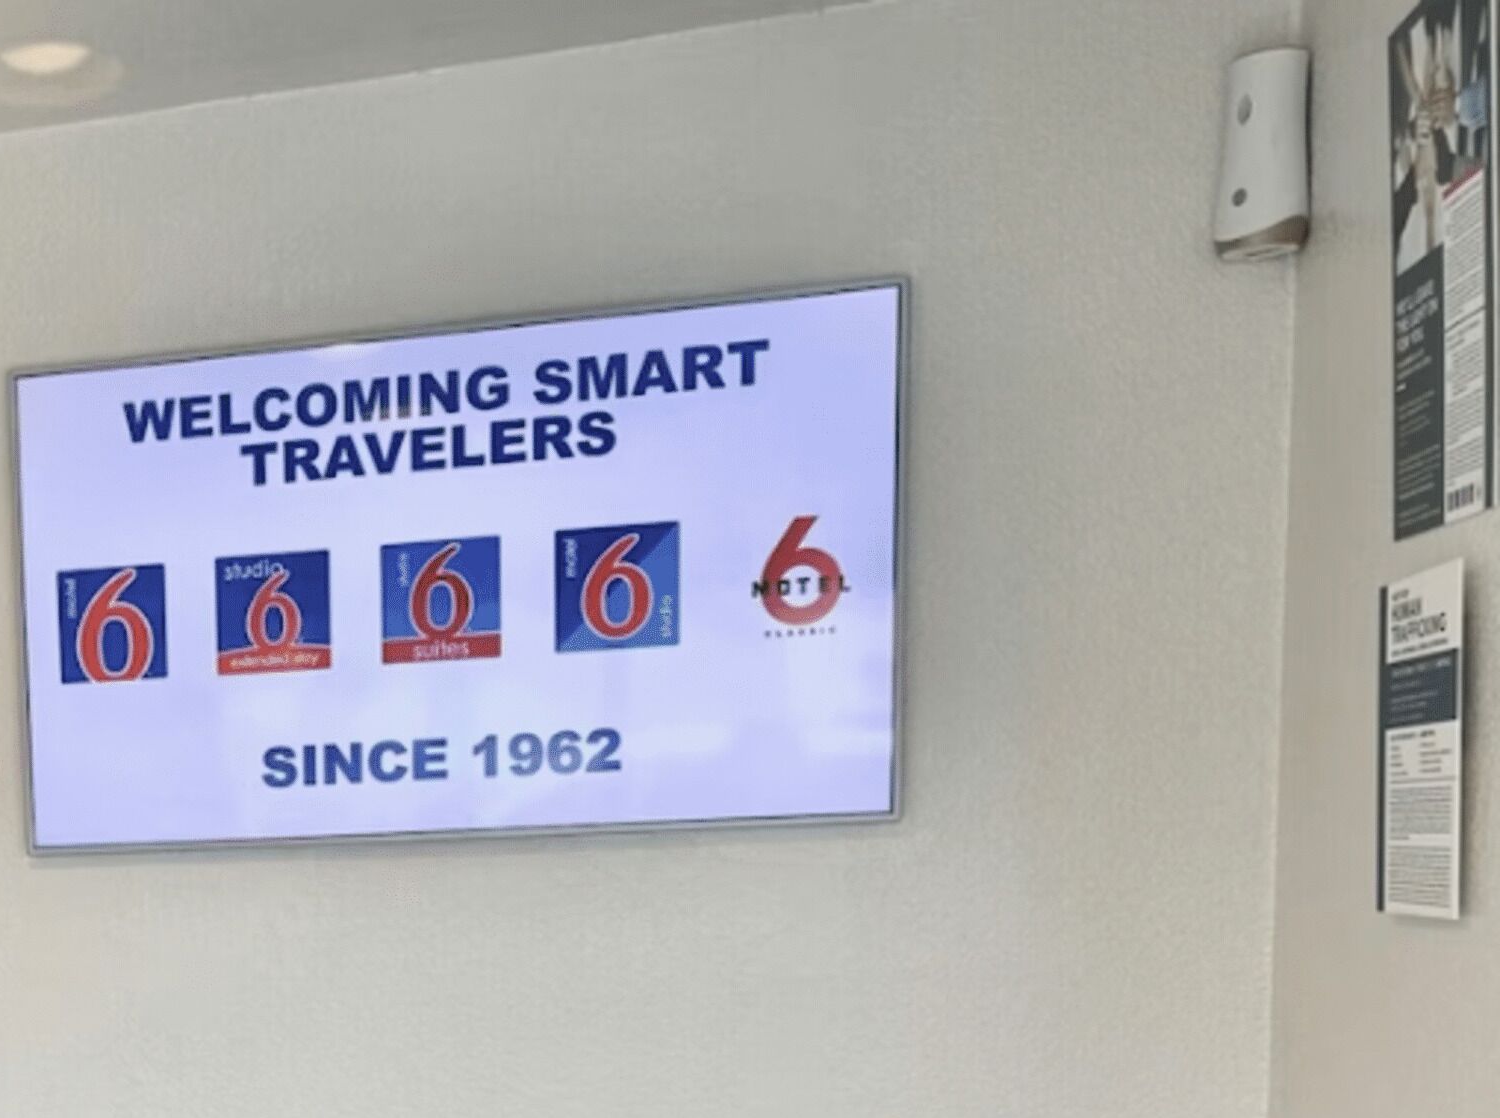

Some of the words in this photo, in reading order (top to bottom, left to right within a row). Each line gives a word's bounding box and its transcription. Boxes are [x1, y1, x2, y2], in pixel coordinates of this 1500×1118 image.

[122, 366, 510, 443] WELCOMING
[533, 338, 770, 405] SMART
[240, 411, 617, 486] TRAVELERS
[223, 558, 284, 582] studio
[246, 568, 302, 650] 6
[409, 541, 475, 640] 6
[580, 532, 653, 641] 6
[761, 514, 843, 624] 6
[76, 567, 154, 684] 6
[413, 638, 470, 660] suites
[261, 738, 449, 788] SINCE
[472, 727, 622, 778] 1962
